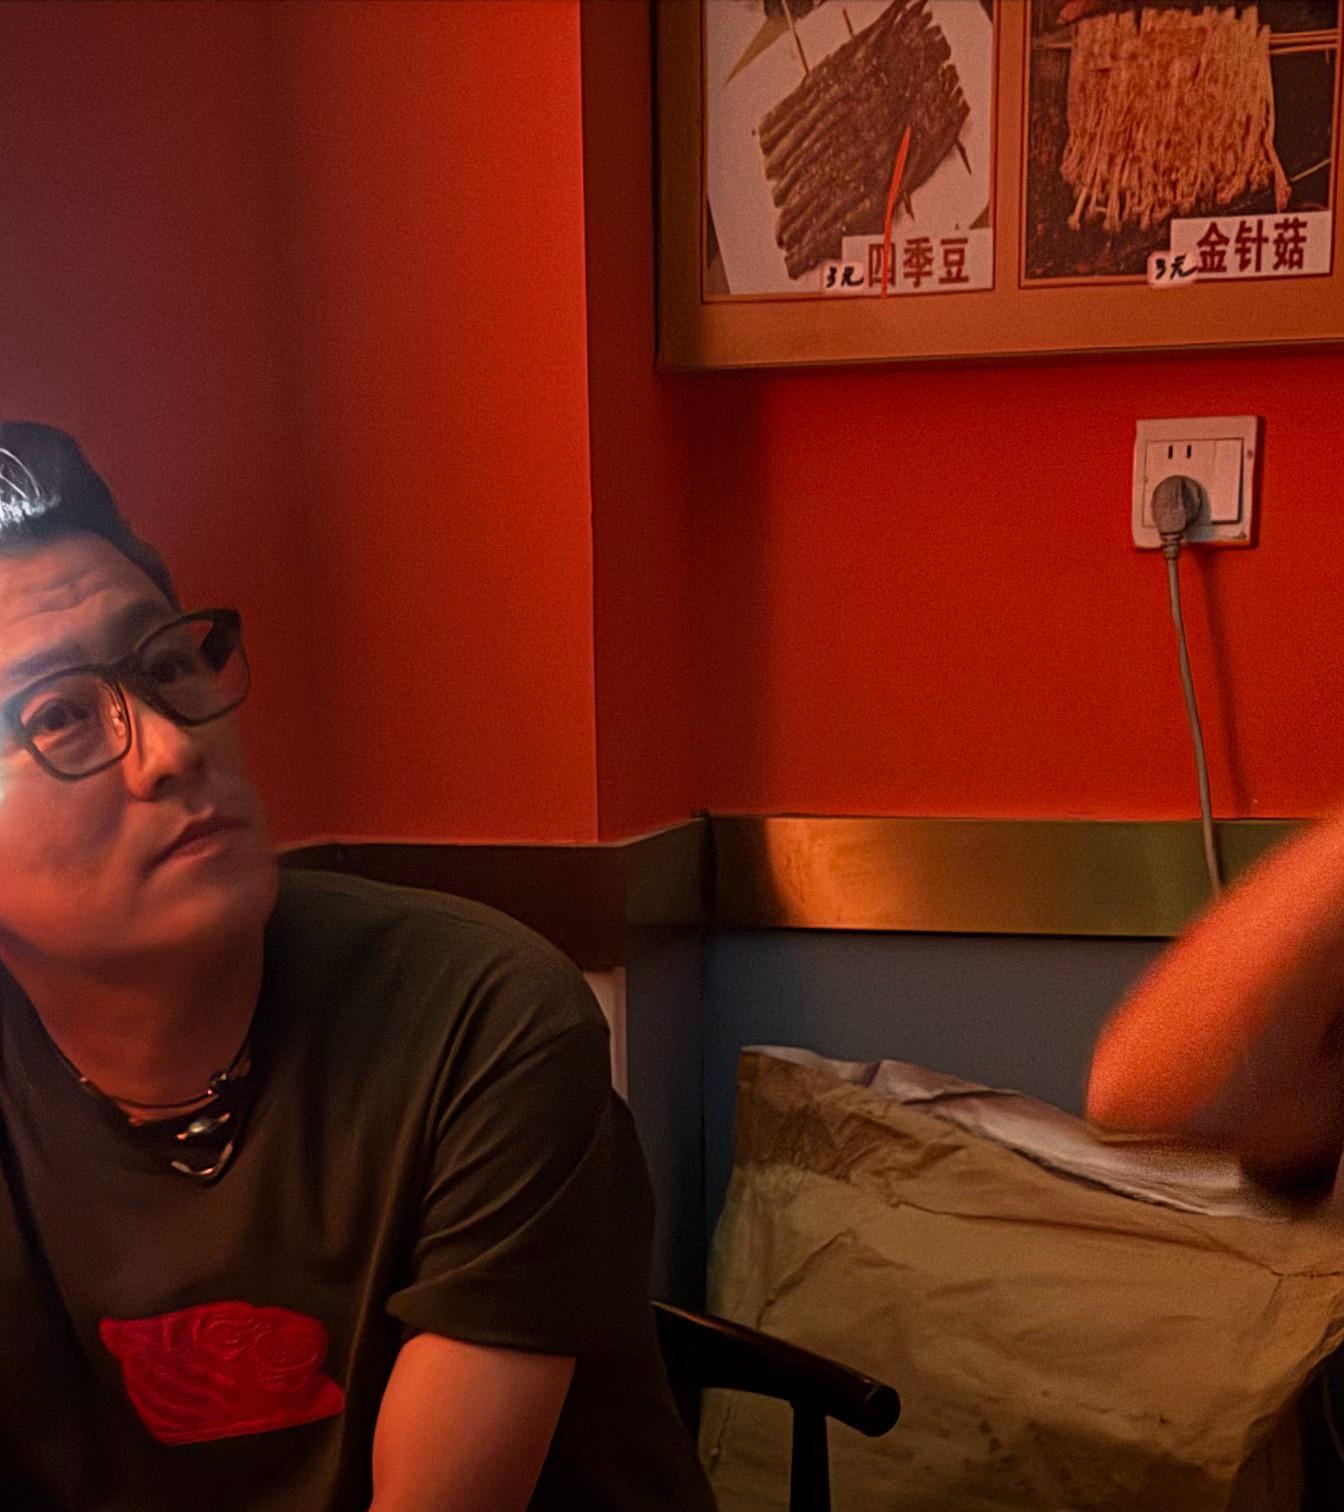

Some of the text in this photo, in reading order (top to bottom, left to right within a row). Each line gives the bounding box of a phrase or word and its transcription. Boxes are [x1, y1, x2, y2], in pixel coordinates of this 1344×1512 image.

[868, 236, 969, 288] 四季豆
[1155, 254, 1198, 280] 3元
[1196, 217, 1308, 273] 金针菇
